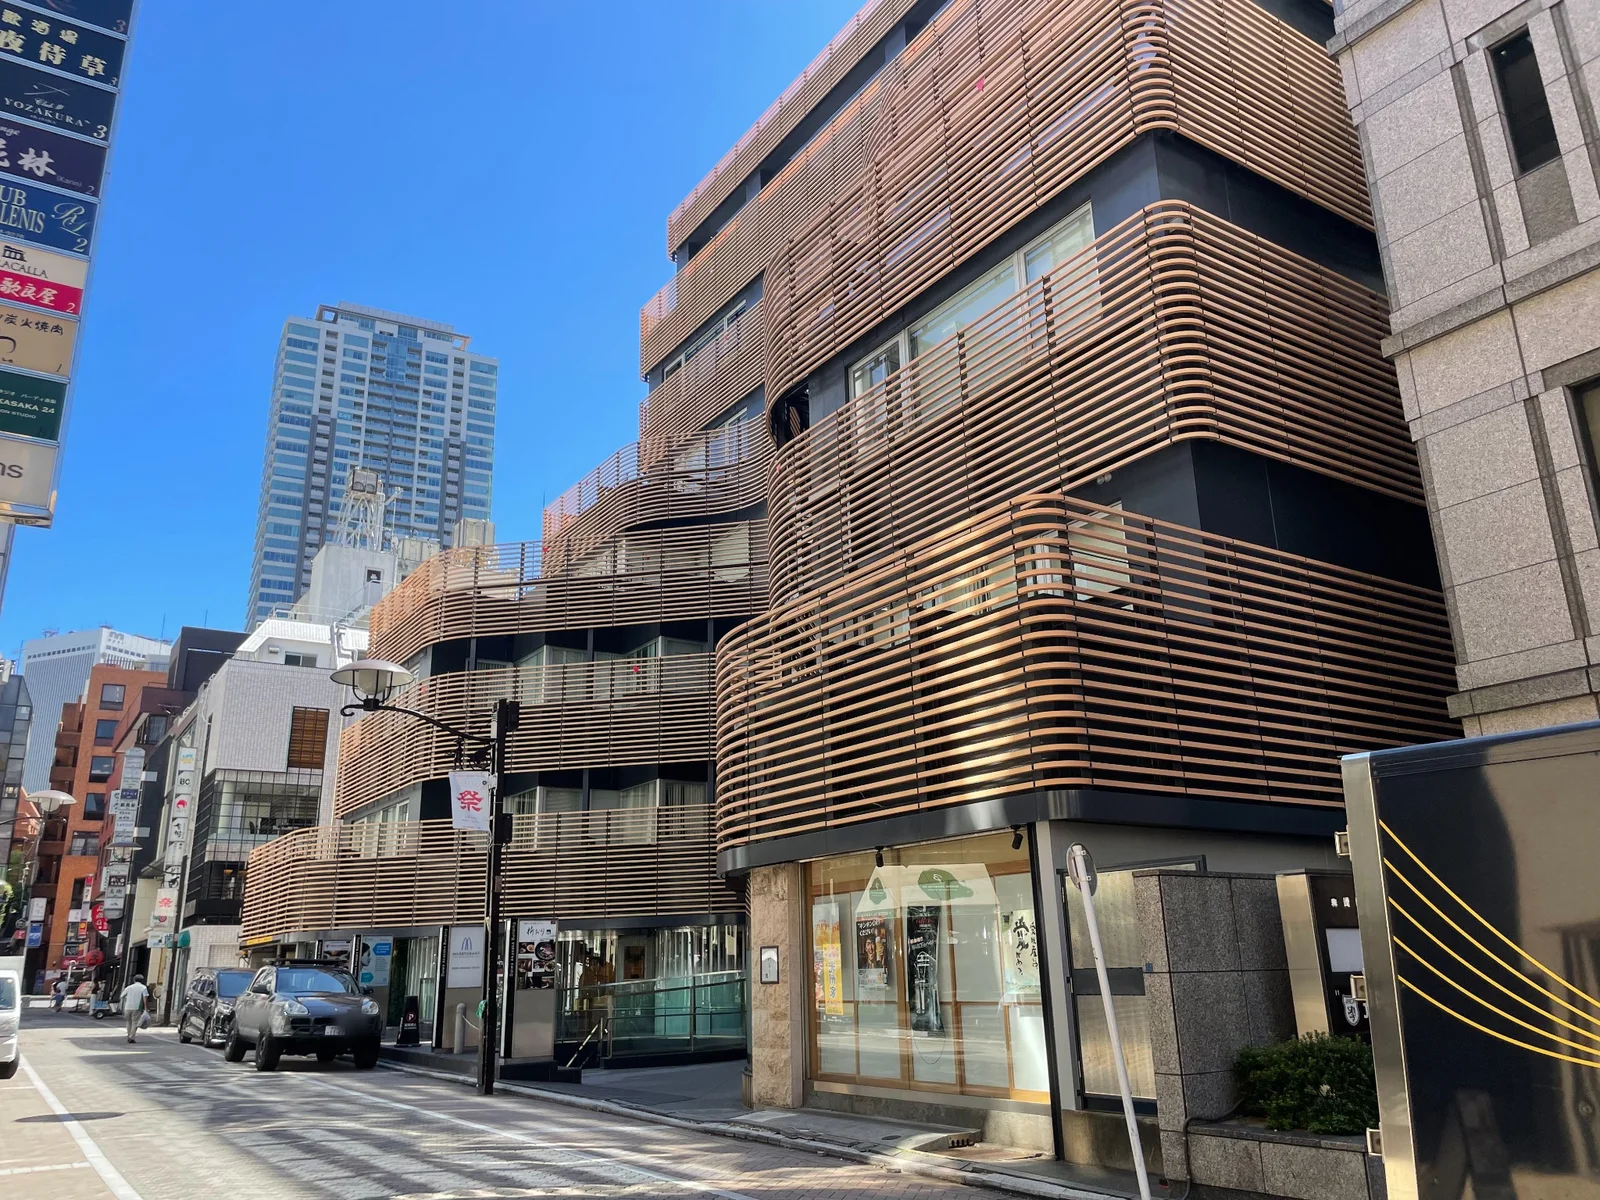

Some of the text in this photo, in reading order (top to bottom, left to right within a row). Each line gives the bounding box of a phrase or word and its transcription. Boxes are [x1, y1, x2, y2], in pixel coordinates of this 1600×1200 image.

[113, 20, 126, 32] 3
[108, 77, 118, 87] 3
[4, 98, 84, 127] YOZAKURA
[93, 124, 108, 139] 3
[85, 185, 95, 195] 2
[73, 238, 88, 252] 2
[66, 302, 76, 313] 2
[11, 410, 37, 419] STUDIO
[42, 406, 55, 414] 24
